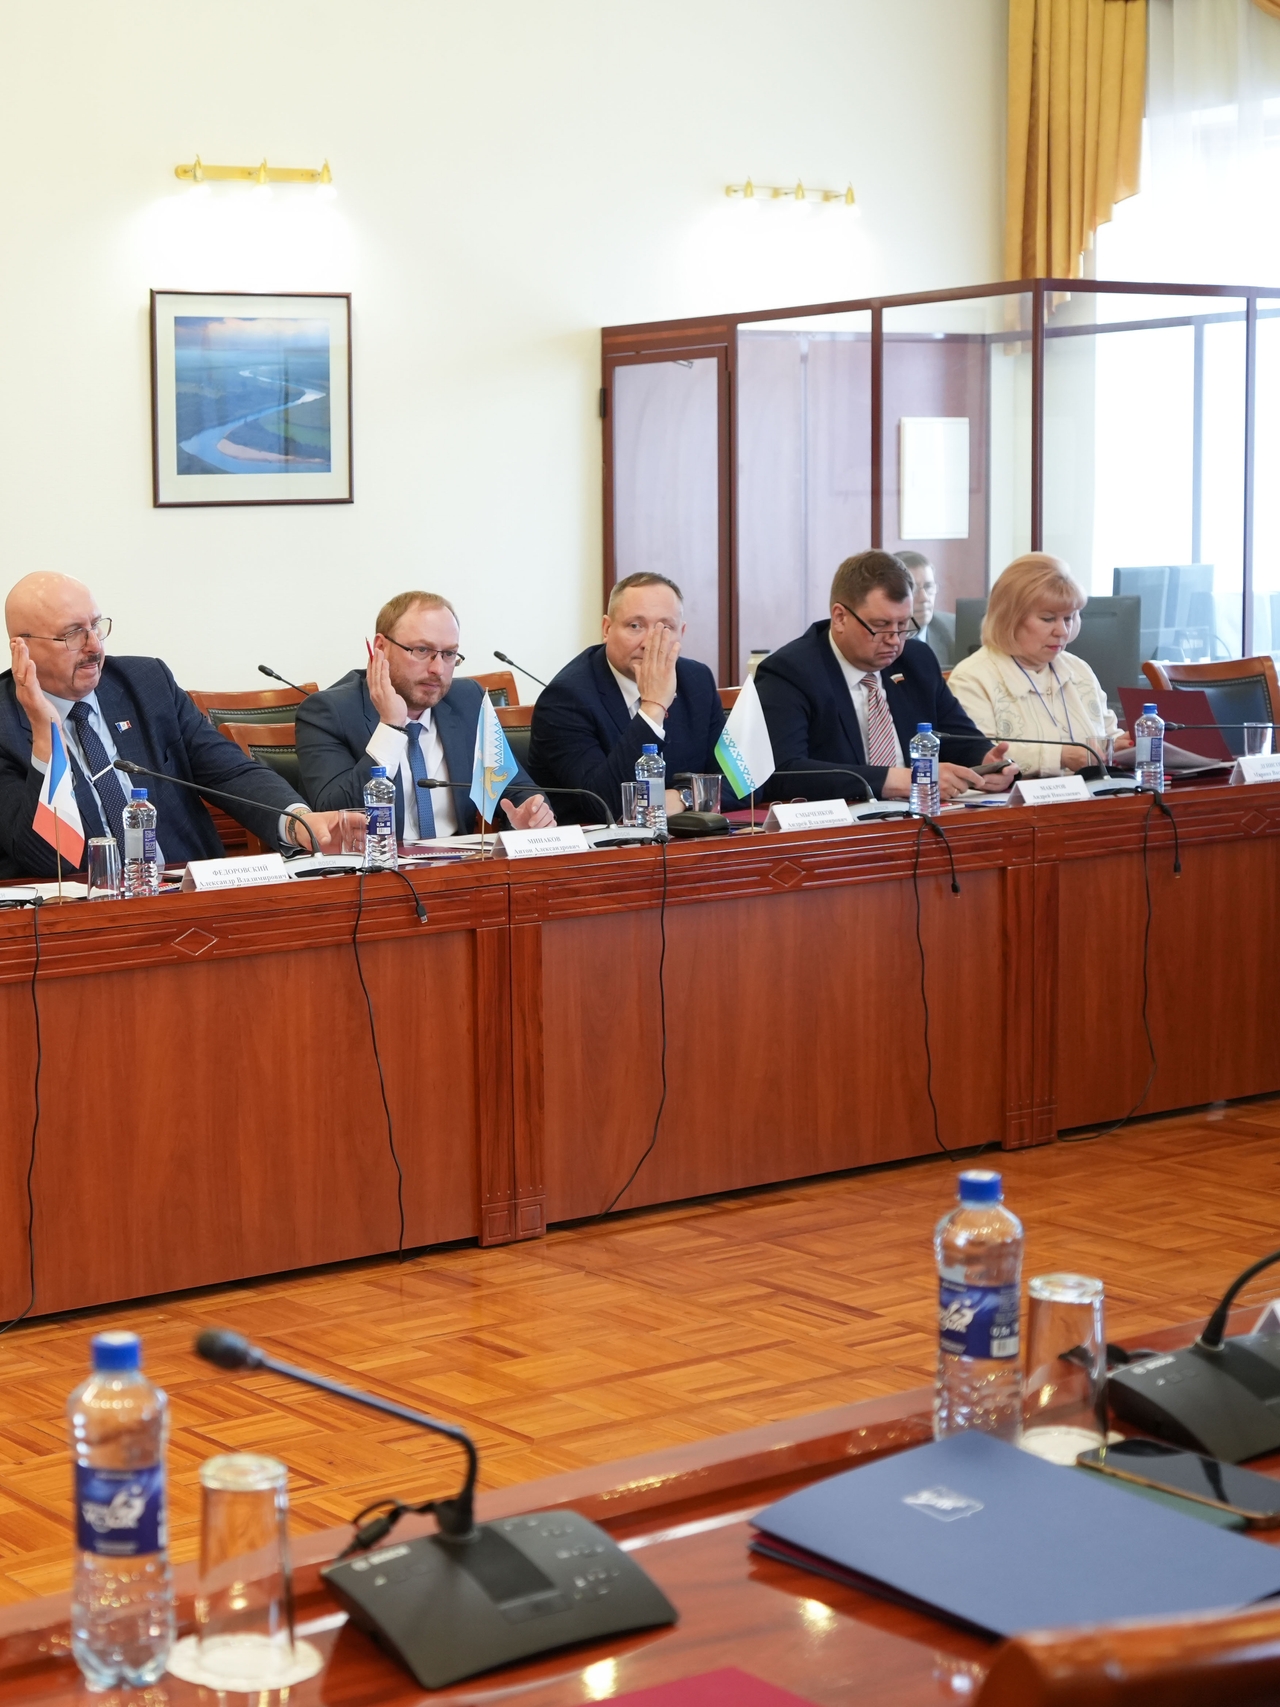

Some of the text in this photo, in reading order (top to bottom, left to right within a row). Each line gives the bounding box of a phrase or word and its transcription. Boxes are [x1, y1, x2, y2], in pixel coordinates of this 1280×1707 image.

[527, 836, 562, 845] МИНАКОВ
[212, 865, 269, 877] ФЕДОРОВСКИЙ
[198, 873, 288, 889] Александр Владимирович
